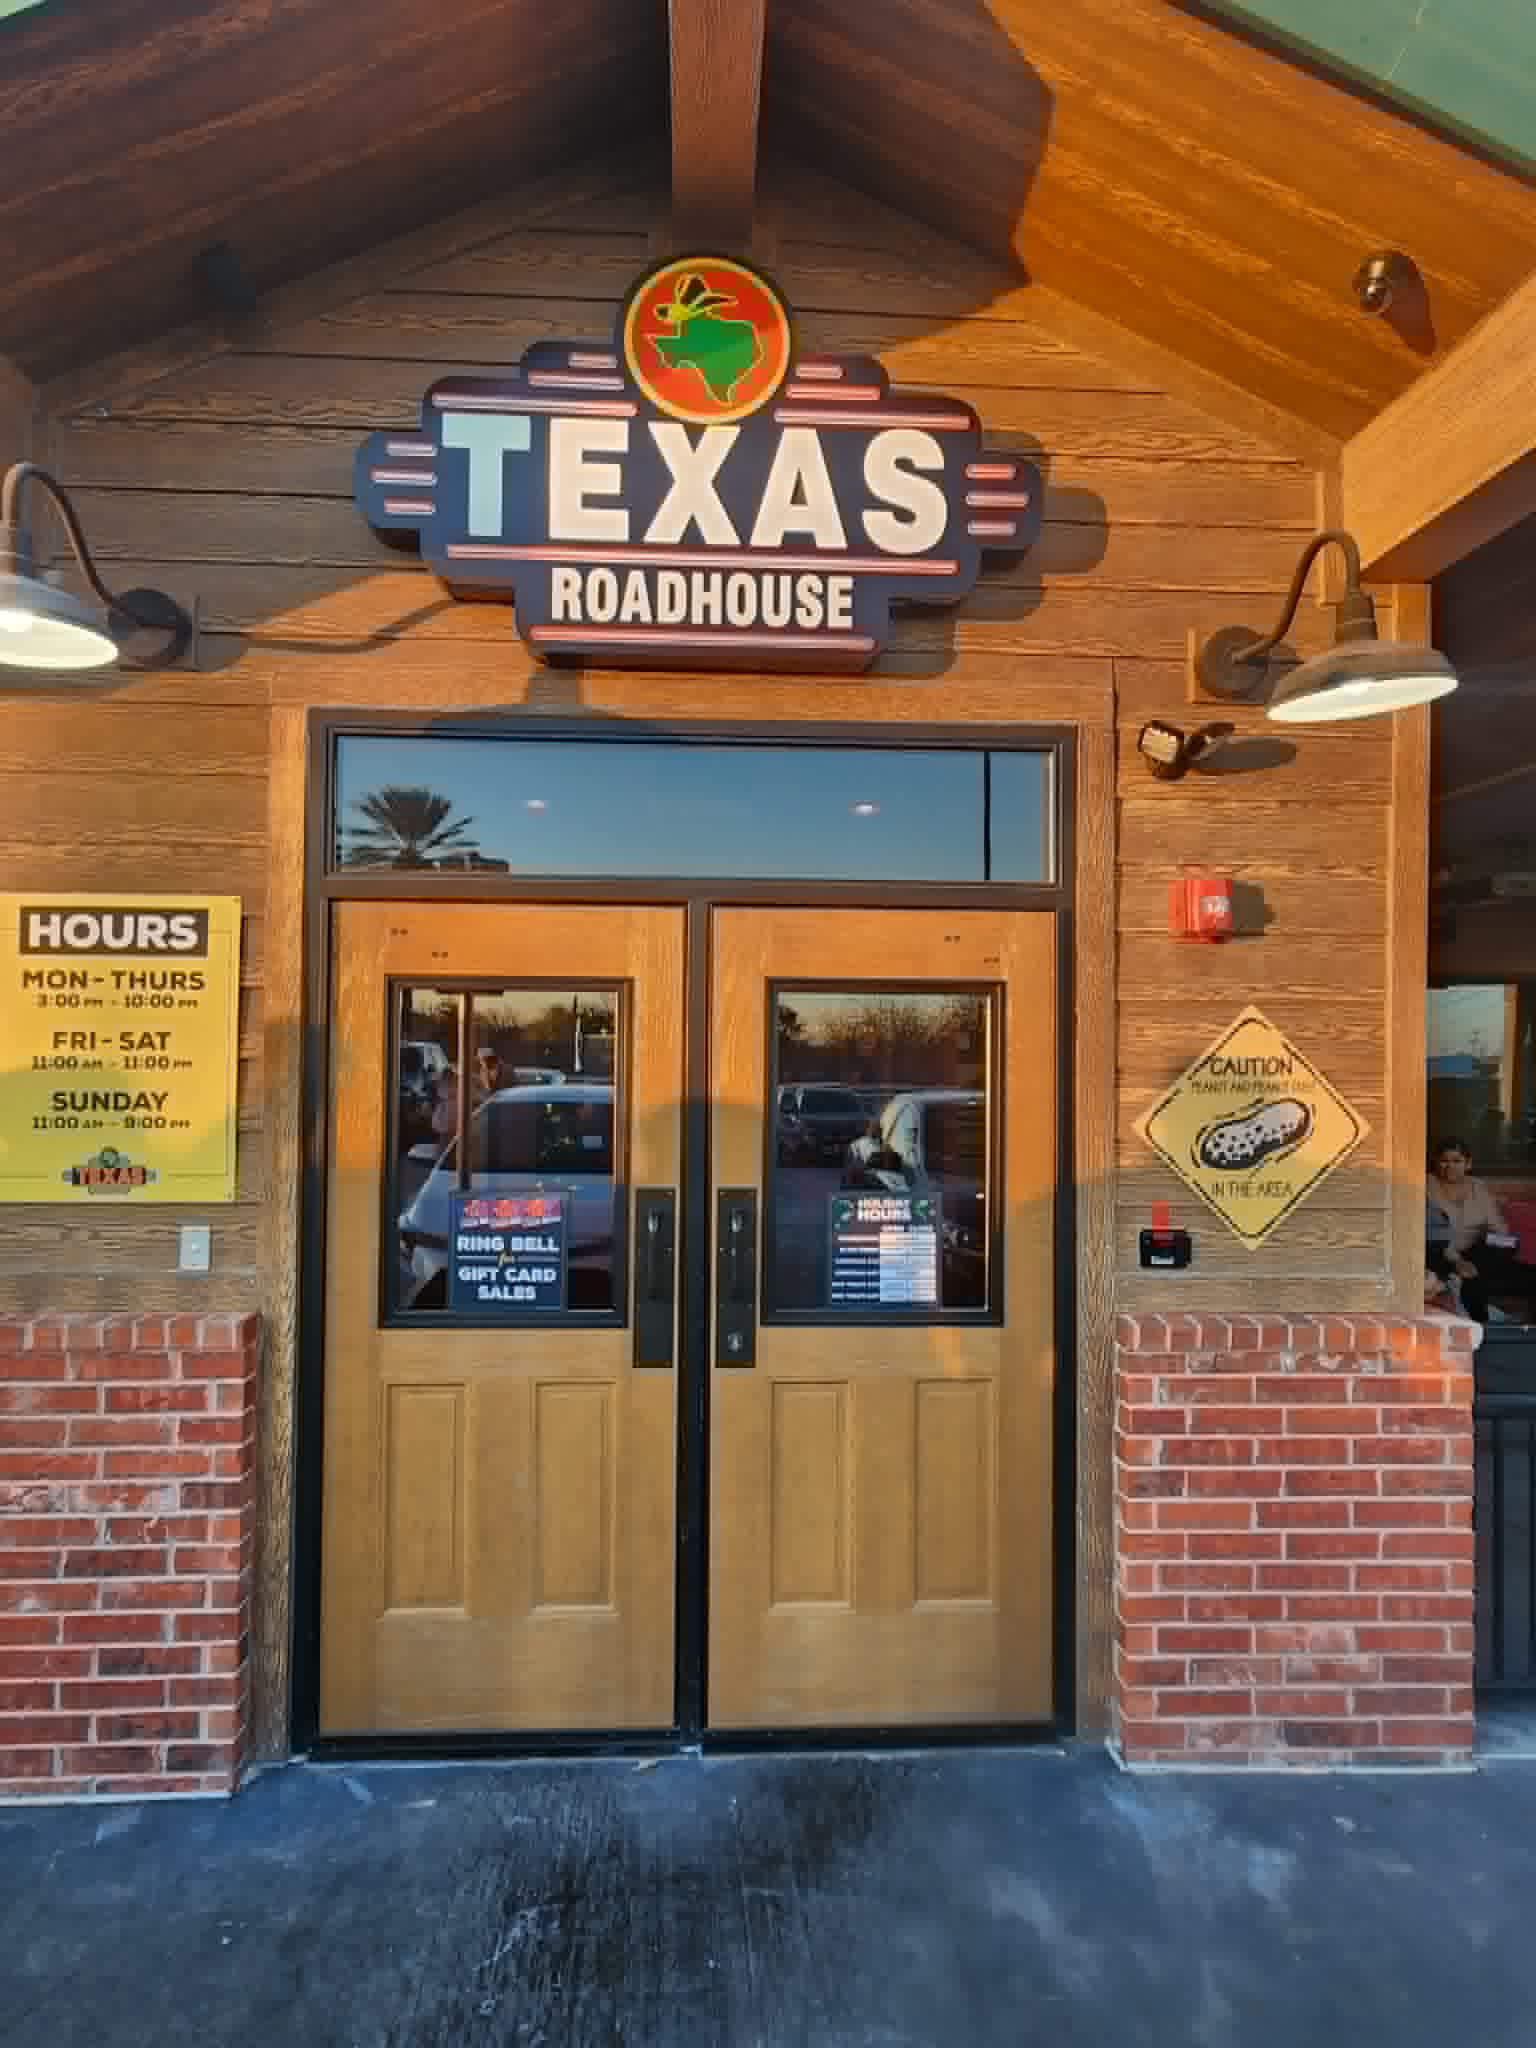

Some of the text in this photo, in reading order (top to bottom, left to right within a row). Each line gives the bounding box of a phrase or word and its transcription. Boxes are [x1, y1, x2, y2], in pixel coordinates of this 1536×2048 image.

[440, 414, 948, 556] TEXAS
[550, 567, 854, 628] ROADHOUSE
[28, 912, 199, 951] HOURS
[22, 969, 88, 990] MON
[110, 969, 206, 991] THURS
[53, 1031, 97, 1050] FRI
[120, 1031, 172, 1051] SAT
[1210, 1056, 1293, 1076] CAUTION
[52, 1091, 169, 1112] SUNDAY
[1210, 1180, 1224, 1199] IN
